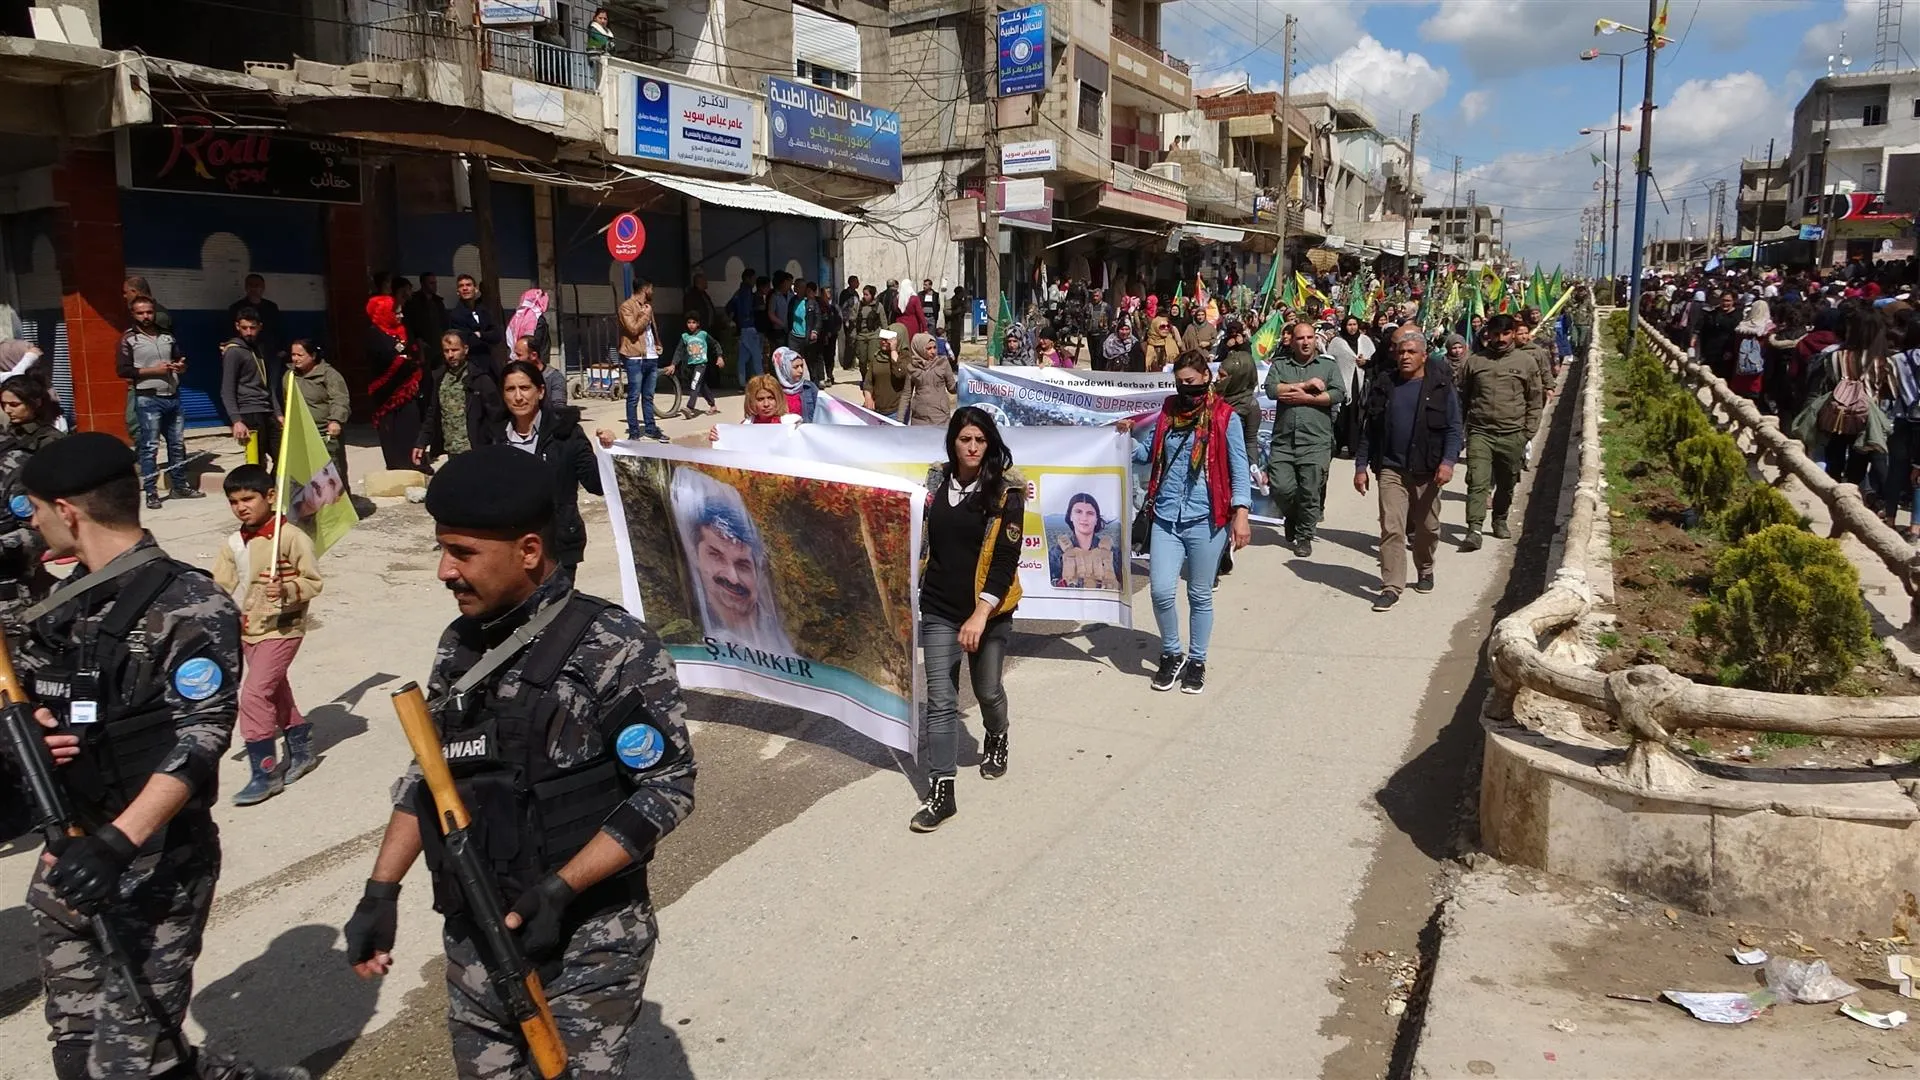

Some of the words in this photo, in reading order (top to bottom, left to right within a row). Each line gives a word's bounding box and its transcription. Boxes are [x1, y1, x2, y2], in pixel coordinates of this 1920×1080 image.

[697, 95, 729, 109] الدكتور
[770, 81, 808, 110] الطبية
[810, 93, 848, 121] للتحاليل
[683, 109, 705, 123] سويد
[706, 115, 727, 128] عباس
[727, 118, 743, 130] عامر
[850, 107, 873, 127] كلو
[875, 114, 898, 135] مخبر
[157, 115, 272, 180] Rodi
[967, 379, 1015, 398] TURKISH
[1018, 386, 1092, 408] OCCUPATION
[1095, 396, 1162, 413] SUPPRESS
[703, 636, 814, 679] Ş.KARKER
[442, 734, 487, 759] AWARÎ
